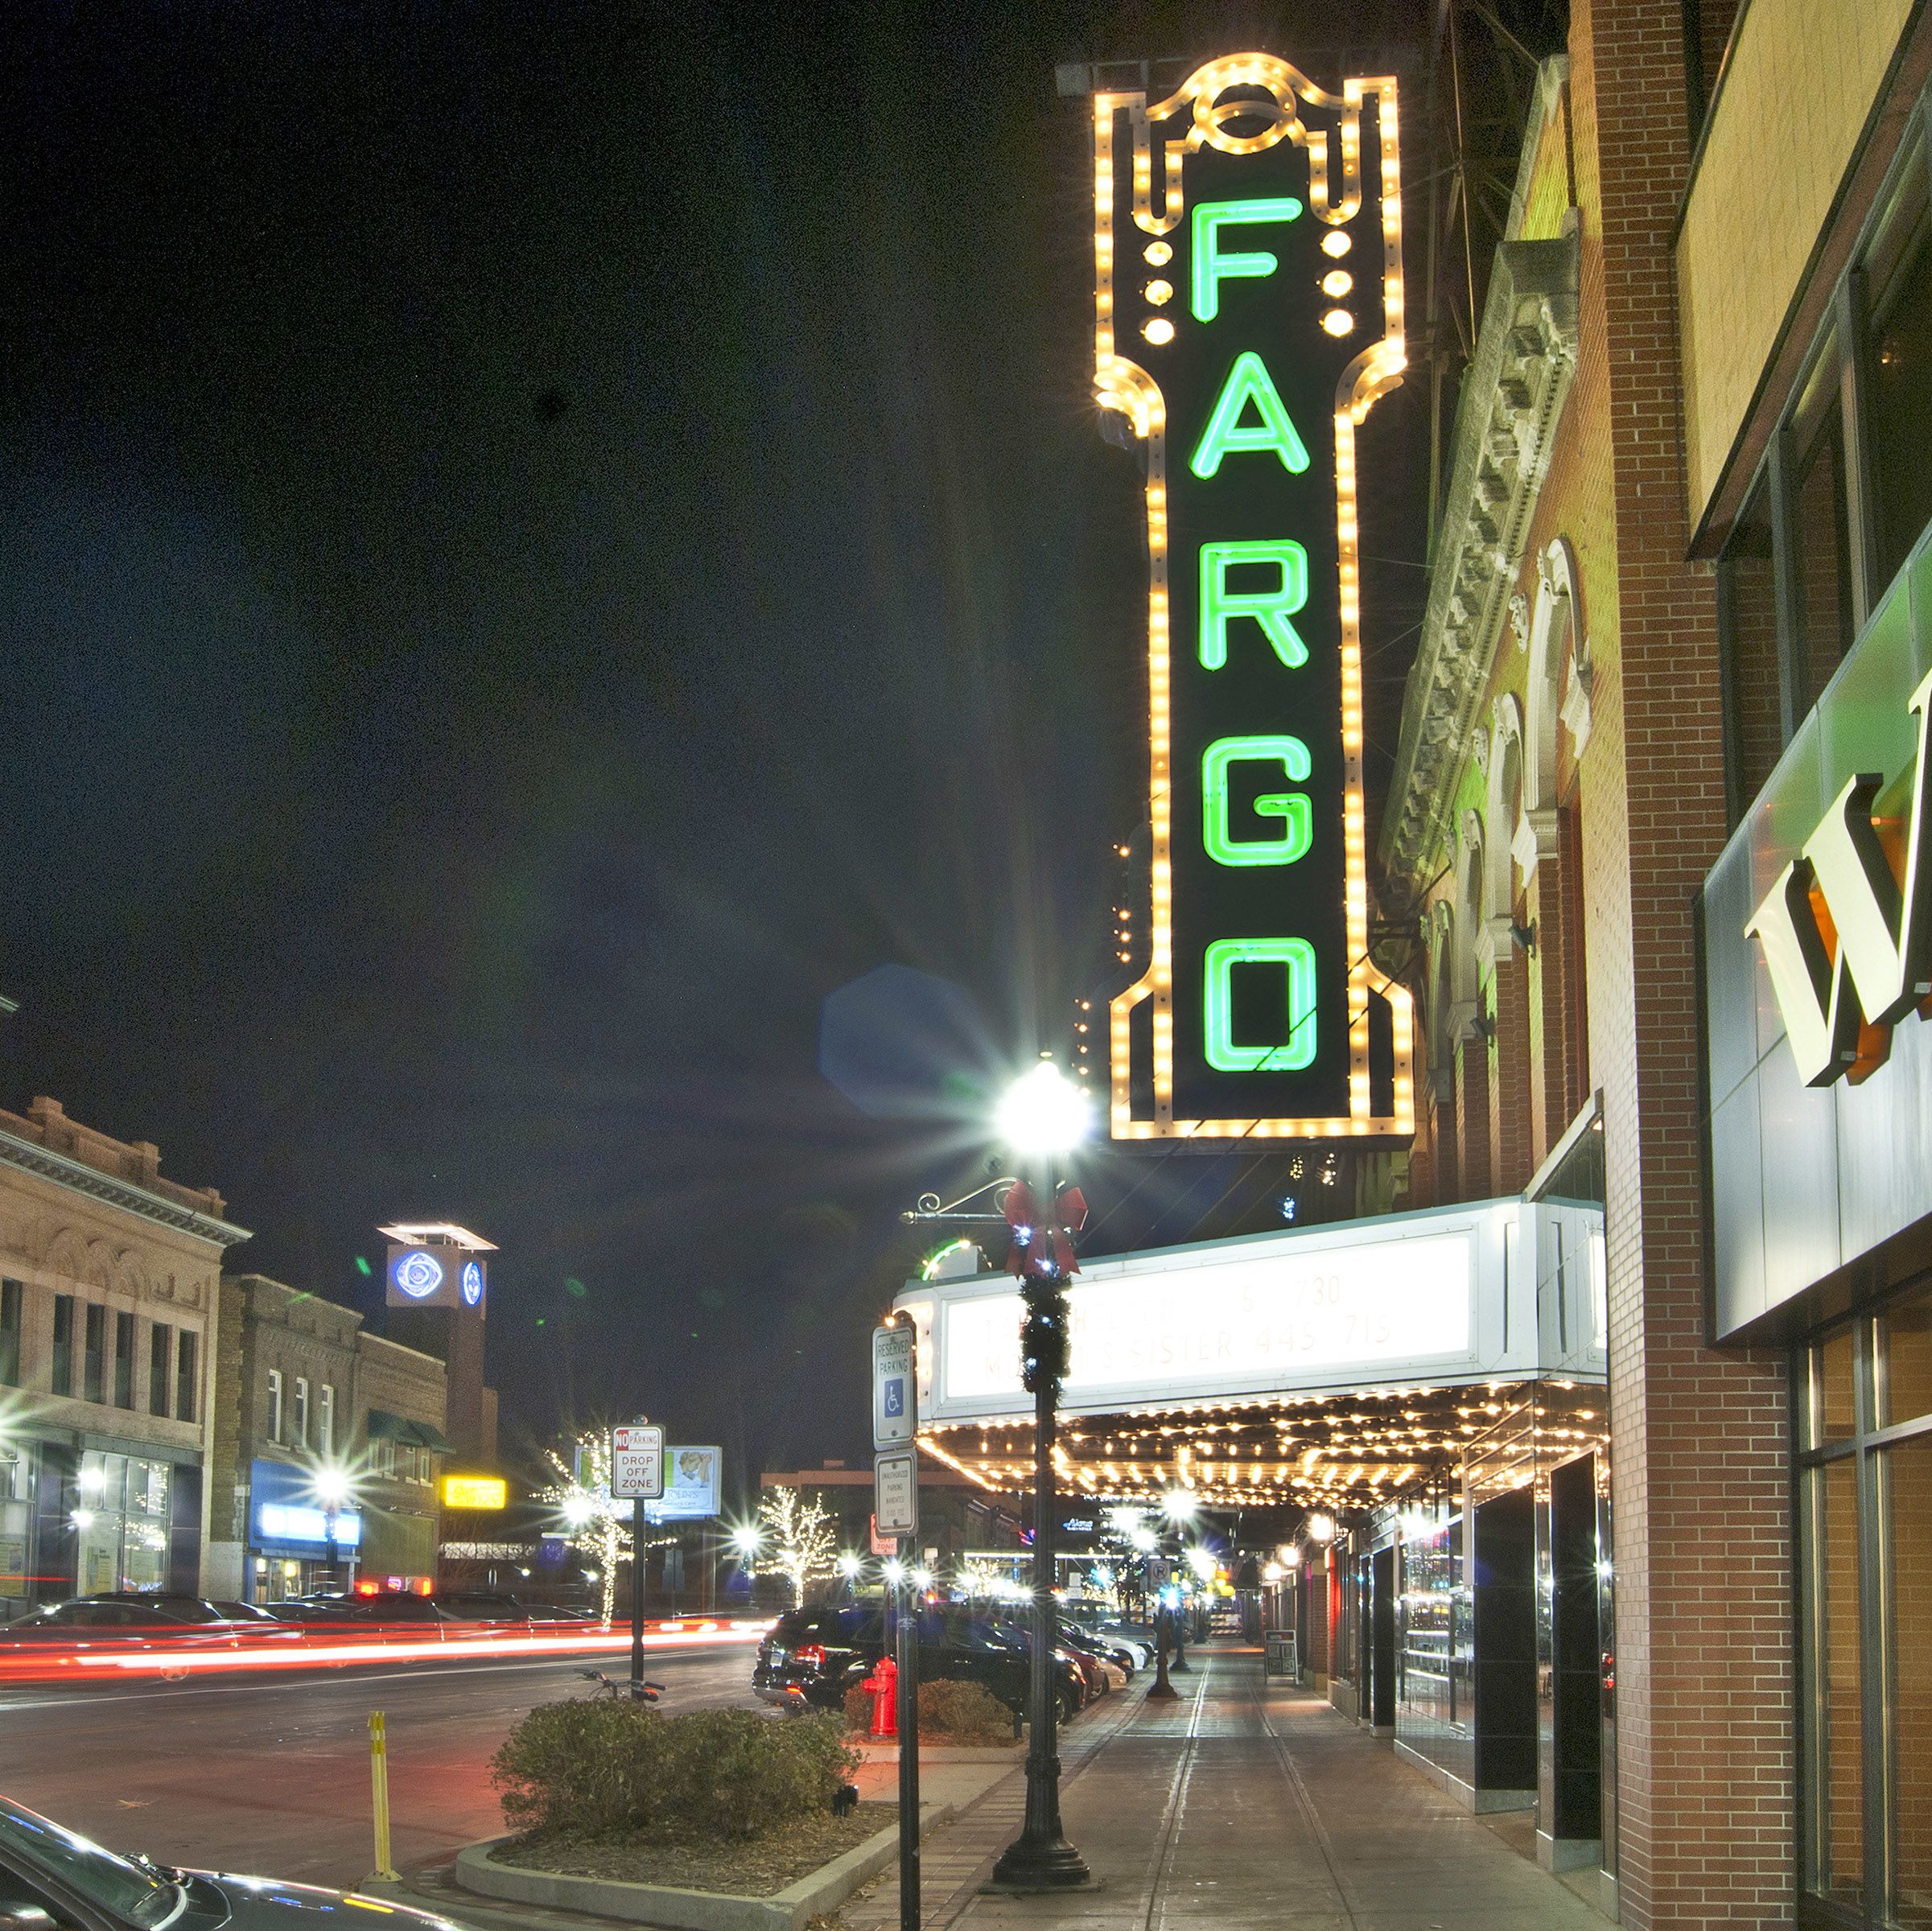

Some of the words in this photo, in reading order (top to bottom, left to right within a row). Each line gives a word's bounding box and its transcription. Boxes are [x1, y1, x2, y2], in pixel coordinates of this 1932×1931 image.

[1190, 196, 1317, 1073] FARGO
[1295, 1274, 1340, 1307] 730
[878, 1339, 909, 1357] RESERVED
[1127, 1325, 1237, 1371] SISTER
[1254, 1317, 1314, 1354] 445
[1345, 1311, 1390, 1347] 715
[880, 1358, 908, 1375] PARKING
[616, 1434, 628, 1447] NO
[630, 1435, 657, 1445] PARKING
[622, 1456, 653, 1464] DROP
[627, 1468, 649, 1476] OFF
[622, 1480, 653, 1488] ZONE
